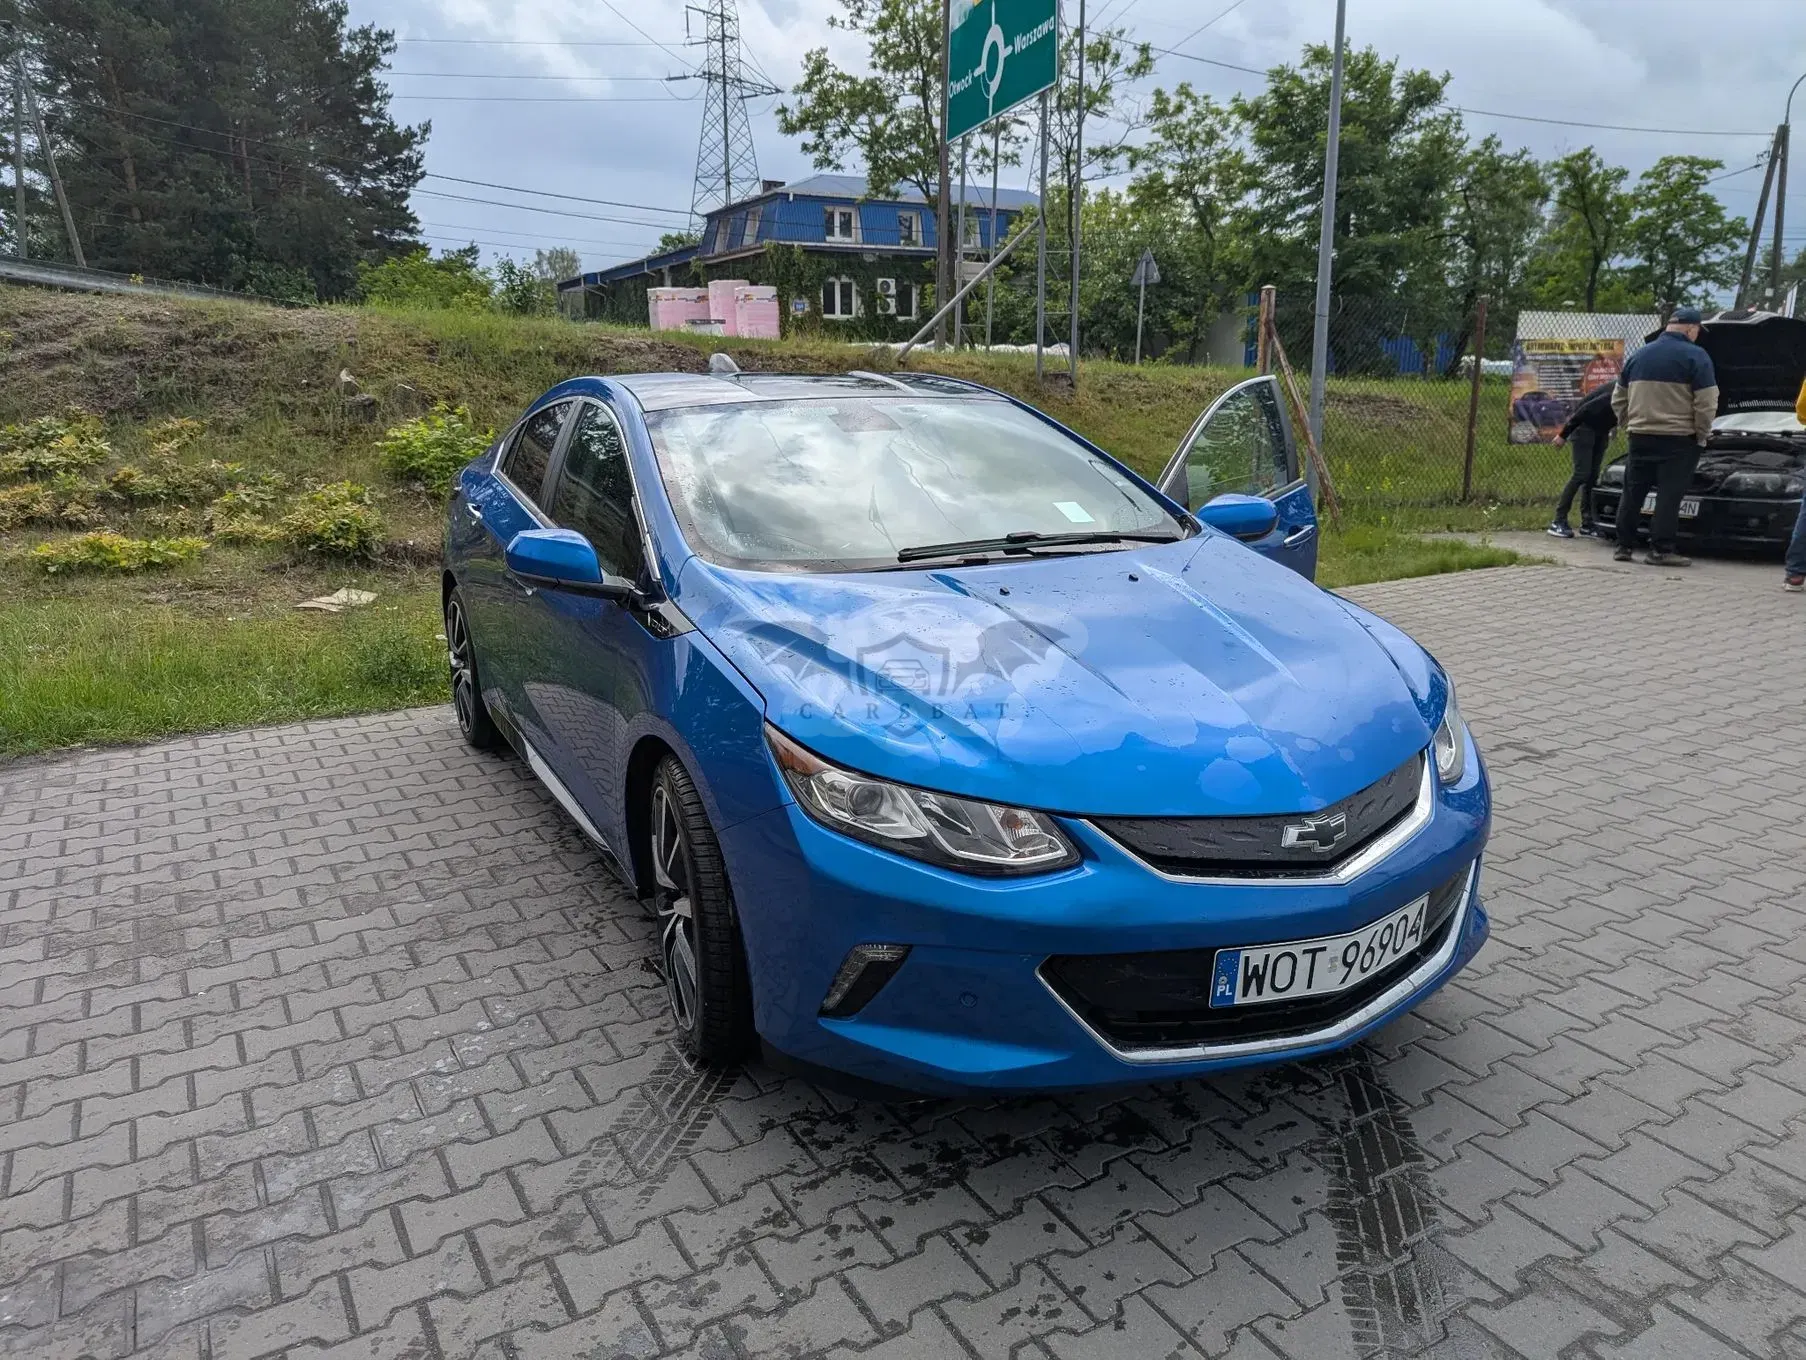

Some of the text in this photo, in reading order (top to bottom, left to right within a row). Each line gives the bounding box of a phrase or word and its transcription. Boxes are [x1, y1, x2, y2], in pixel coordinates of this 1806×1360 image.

[1014, 16, 1054, 55] Warszawa
[948, 69, 973, 98] Otwock
[1242, 902, 1426, 998] WOT 96904
[1216, 985, 1233, 997] PL
